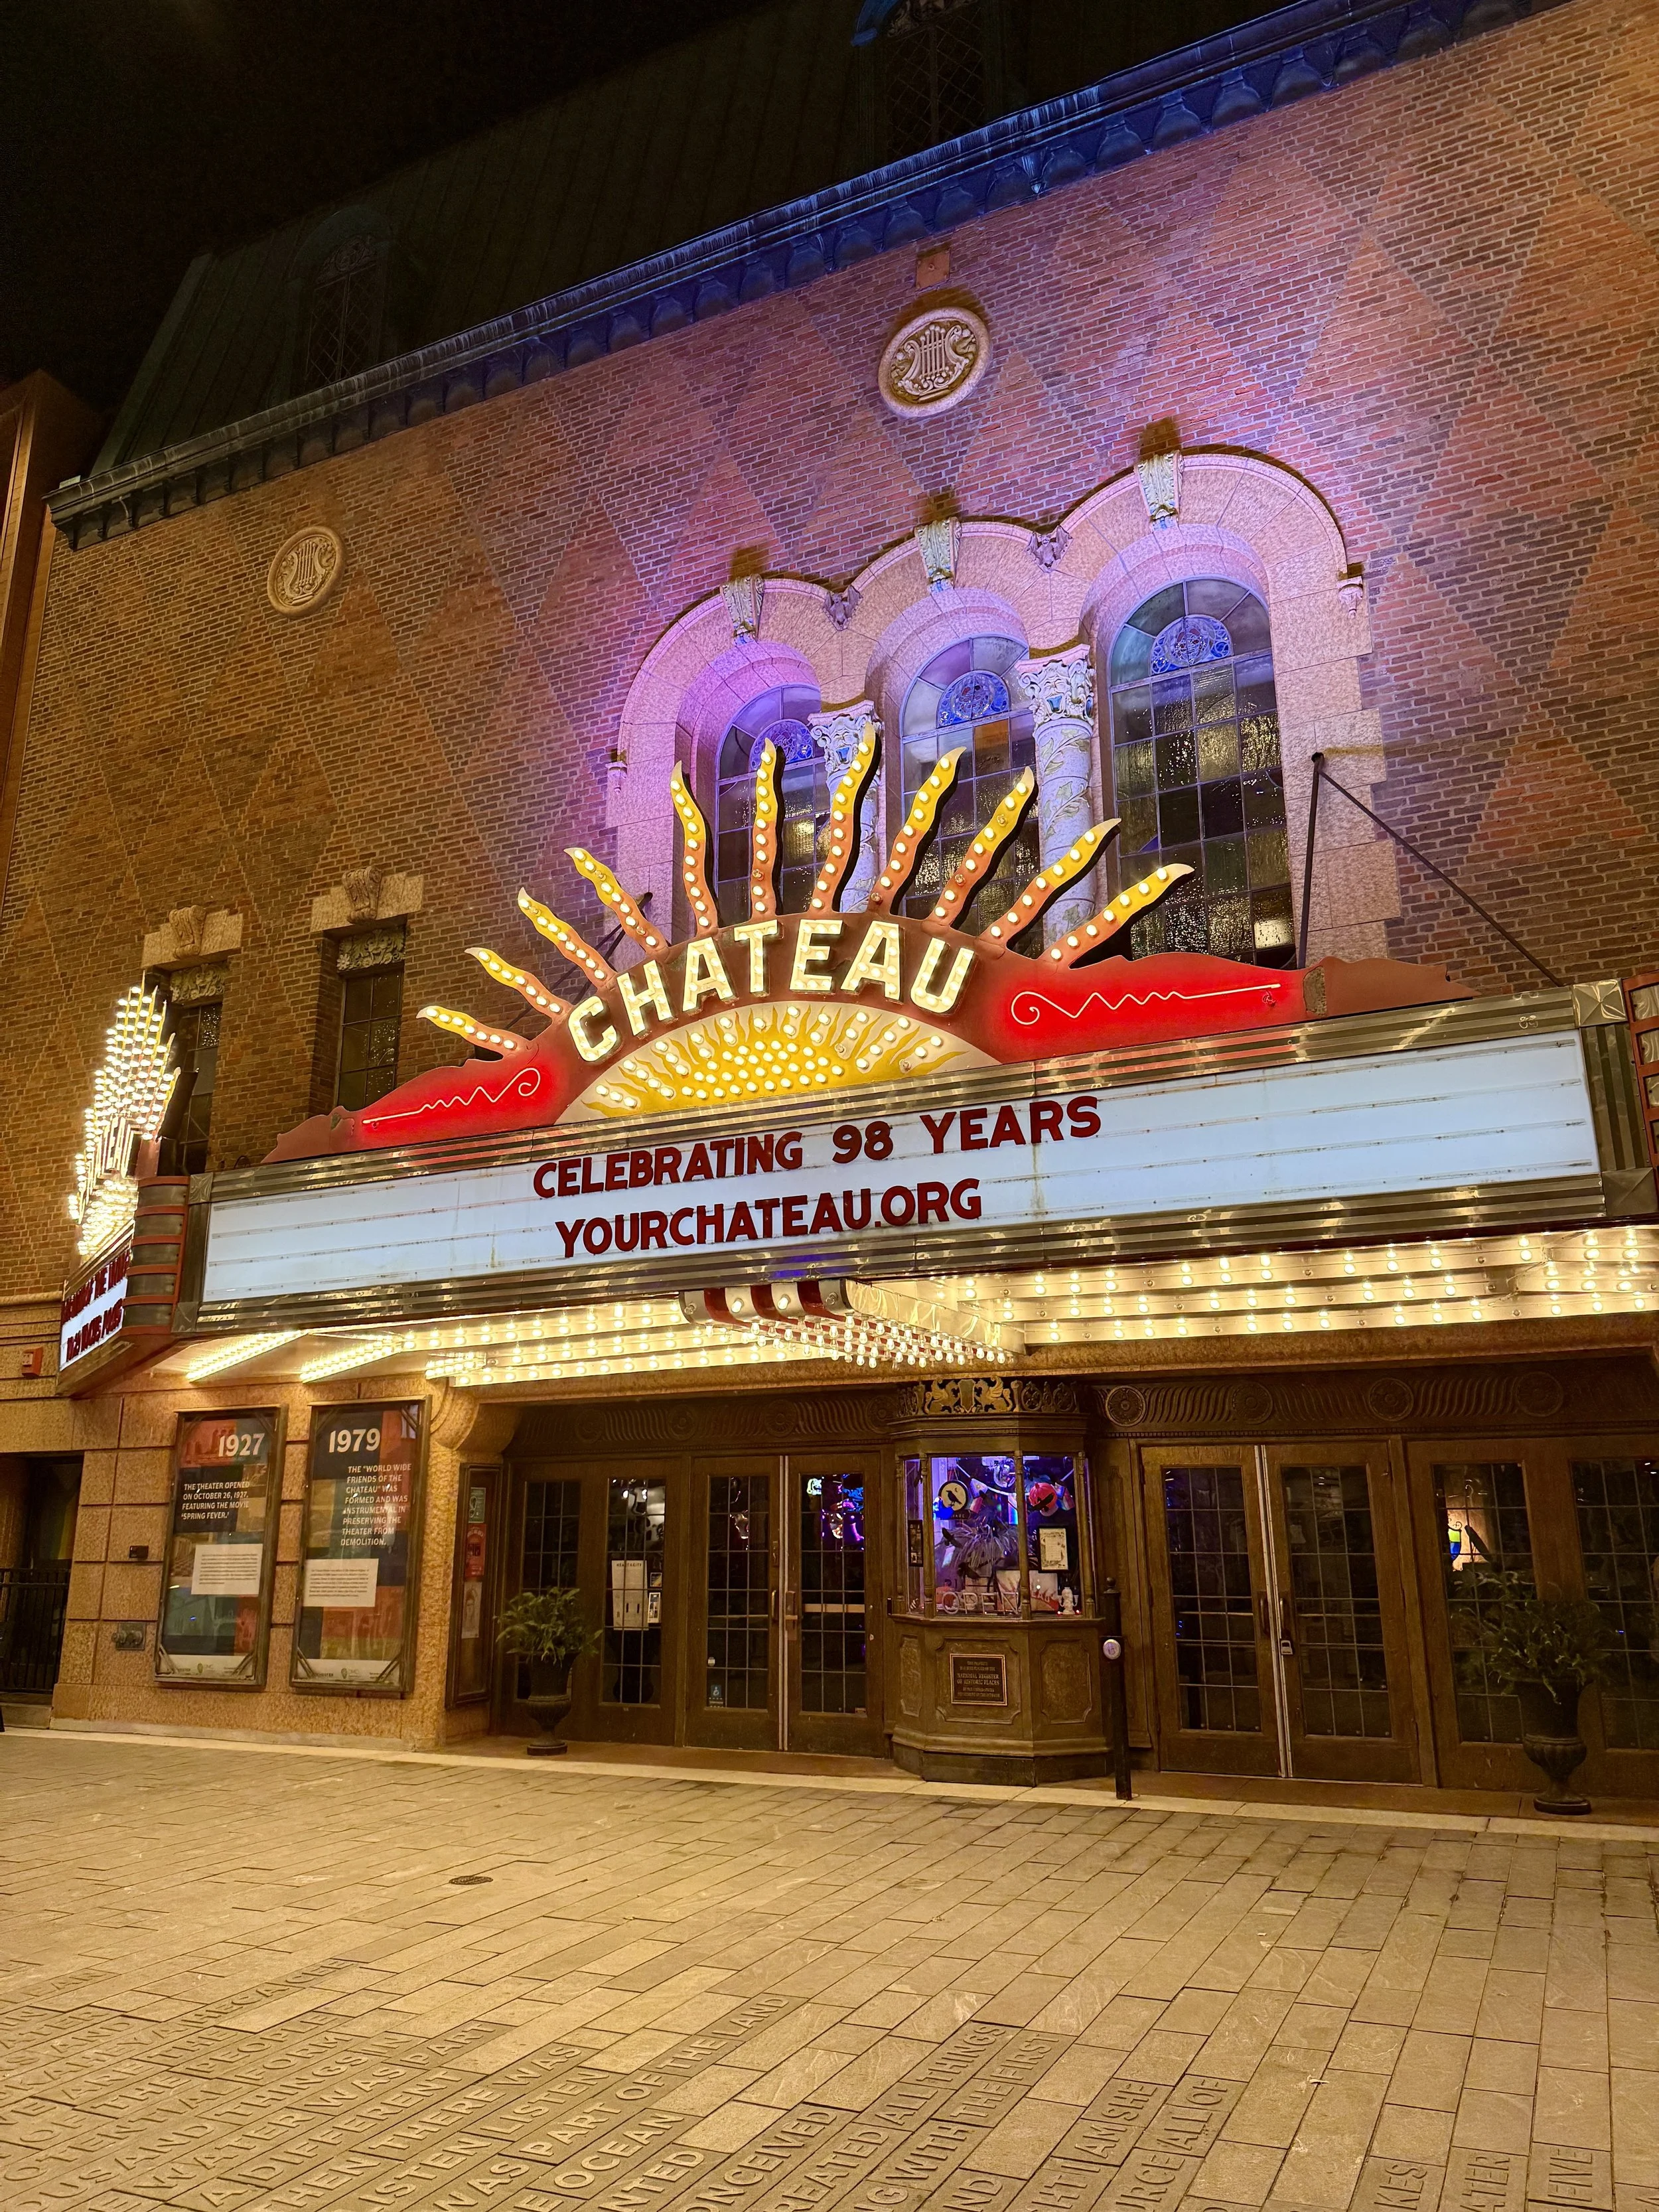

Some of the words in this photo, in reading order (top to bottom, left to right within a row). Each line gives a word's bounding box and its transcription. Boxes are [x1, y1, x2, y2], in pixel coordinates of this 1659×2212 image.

[566, 919, 975, 1063] CHATEAU
[533, 1132, 802, 1199] CELEBRATING
[831, 1120, 894, 1164] 98
[920, 1095, 1102, 1154] YEARS
[555, 1178, 982, 1258] YOURCHATEAU.ORG
[218, 1432, 265, 1457] 1927
[328, 1428, 381, 1453] 1979
[344, 1506, 398, 1514] INSTRUMENTAL
[346, 1485, 381, 1494] CHATEAU"
[942, 1591, 1019, 1615] OPEN
[51, 2022, 133, 2053] AND
[62, 2063, 155, 2100] ARE
[147, 2030, 238, 2059] THE
[214, 2055, 369, 2117] THINGS
[361, 2037, 413, 2054] IN
[234, 2031, 353, 2081] FORM
[519, 2102, 621, 2157] PART
[616, 2073, 665, 2101] OF
[657, 2038, 726, 2071] THE
[712, 1997, 790, 2037] LAND
[875, 2089, 939, 2126] ALL
[915, 2026, 1007, 2082] THINGS
[20, 2115, 87, 2142] OF
[91, 2077, 192, 2110] THE
[185, 2014, 338, 2073] PEOPLE
[133, 2109, 317, 2189] WATER
[304, 2066, 407, 2108] WAS
[399, 2023, 496, 2065] PART
[885, 2124, 969, 2179] WITH
[950, 2082, 1015, 2118] THE
[990, 2033, 1060, 2081] FIRST
[1156, 2111, 1213, 2151] ALL
[1186, 2079, 1228, 2106] OF
[200, 2187, 250, 2208] A
[238, 2071, 463, 2181] DIFFERENT
[263, 2156, 381, 2212] HEN
[369, 2088, 506, 2150] THERE
[492, 2046, 581, 2085] WAS
[370, 2137, 492, 2212] ISTEN
[480, 2071, 609, 2134] LISTEN
[553, 2111, 685, 2189] OCEAN
[1031, 2174, 1088, 2212] HT
[1074, 2125, 1127, 2159] AM
[1101, 2083, 1158, 2121] SHE
